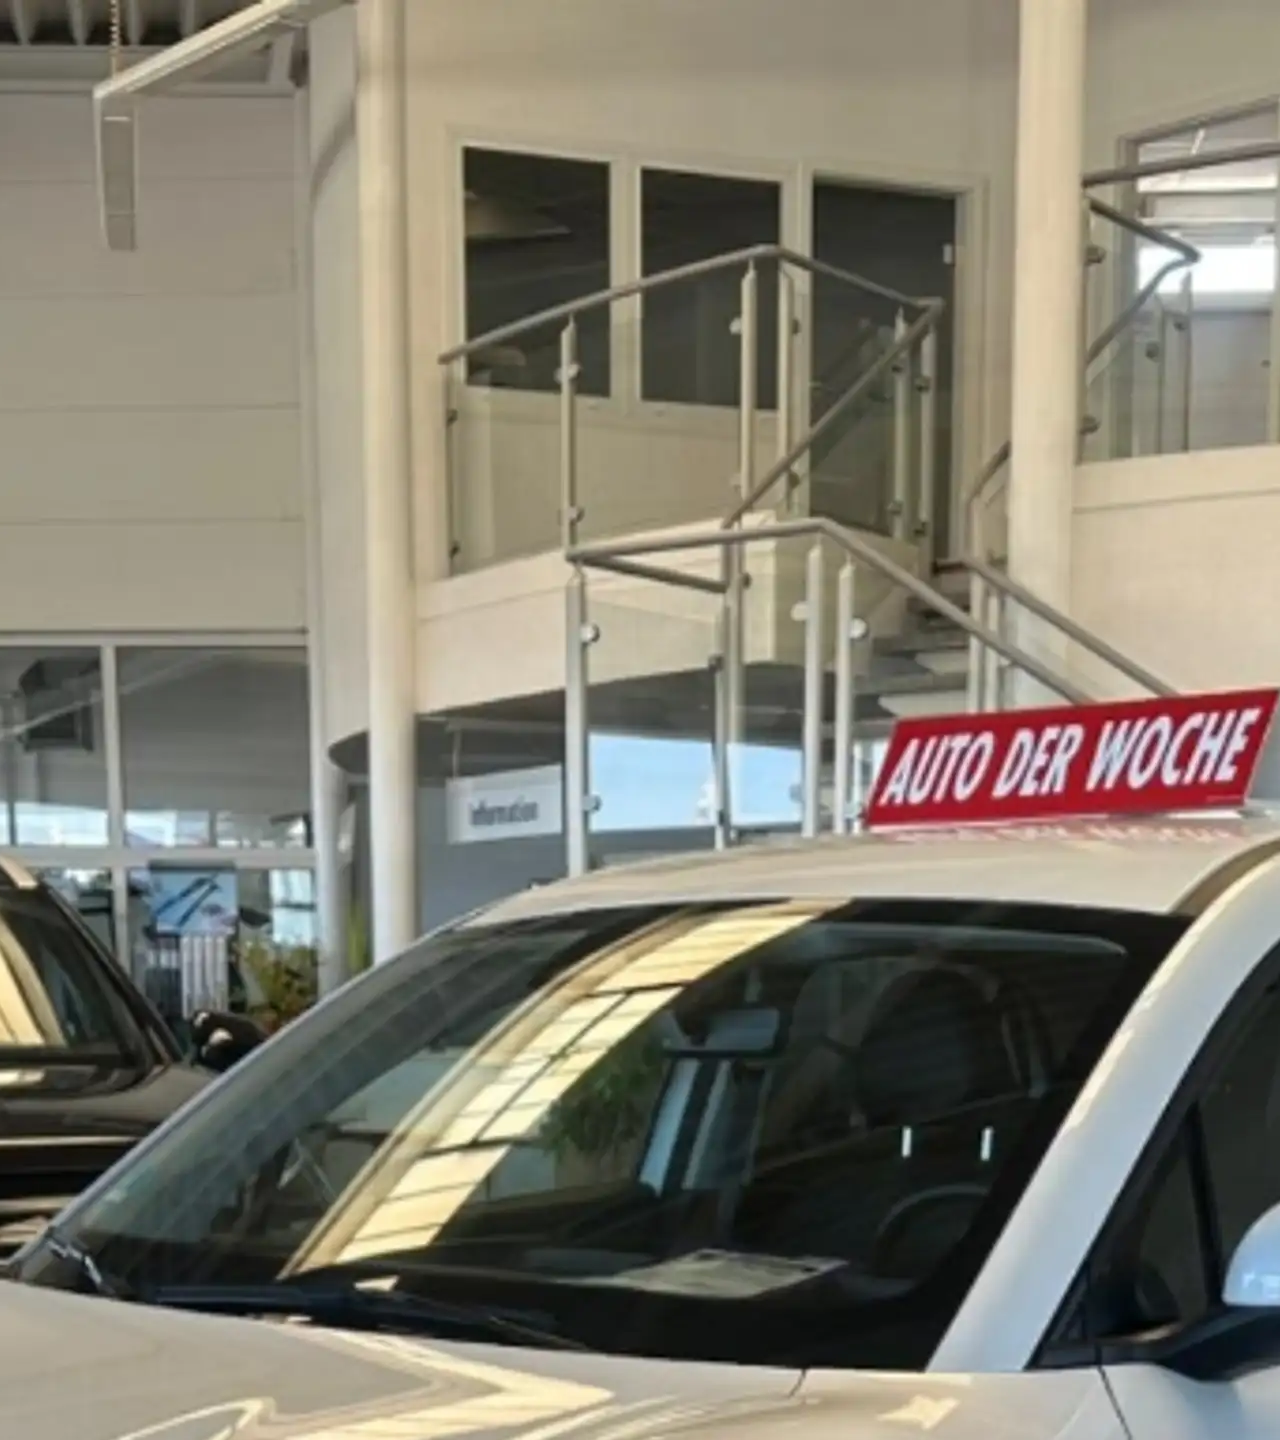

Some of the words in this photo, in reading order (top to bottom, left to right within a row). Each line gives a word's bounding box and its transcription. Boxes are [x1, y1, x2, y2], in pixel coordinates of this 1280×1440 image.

[878, 731, 995, 806] AUTO
[991, 724, 1085, 799] DER
[1084, 706, 1263, 792] WOCHE
